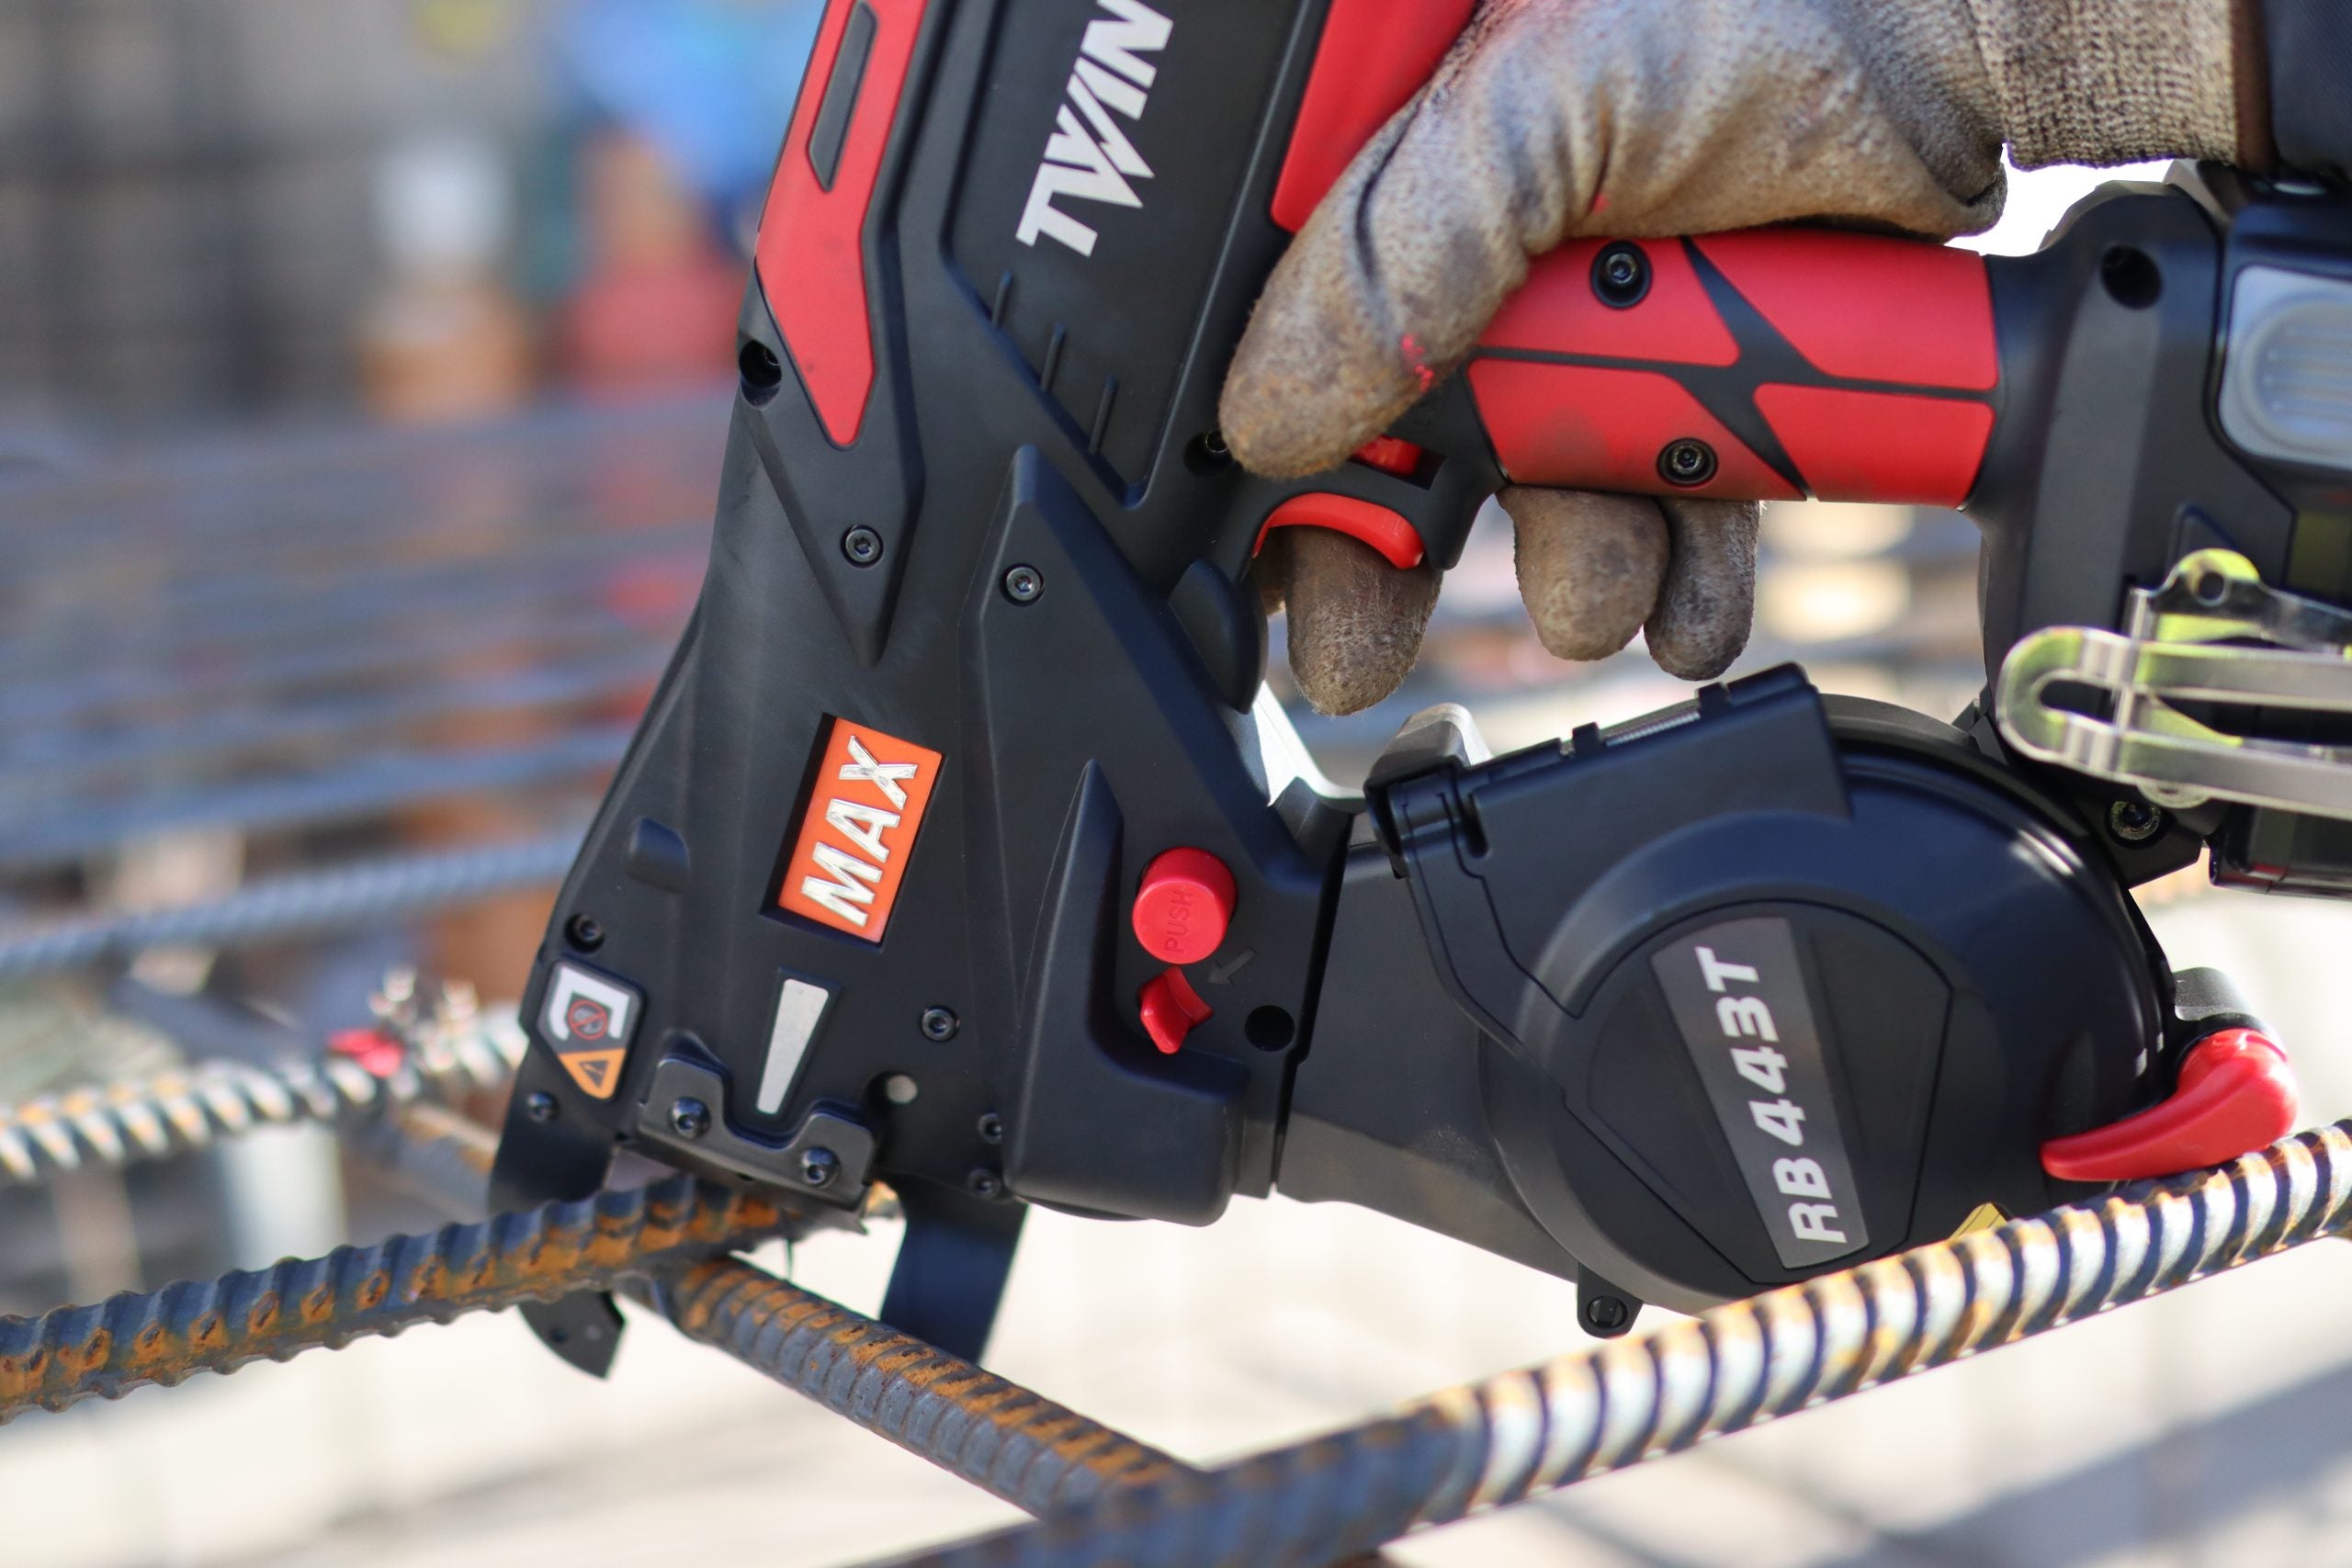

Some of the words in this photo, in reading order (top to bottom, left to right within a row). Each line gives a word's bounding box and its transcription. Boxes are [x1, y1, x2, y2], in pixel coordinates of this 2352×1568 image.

[1014, 0, 1174, 257] TWIN
[800, 735, 918, 928] MAX
[1163, 886, 1193, 954] PUSH
